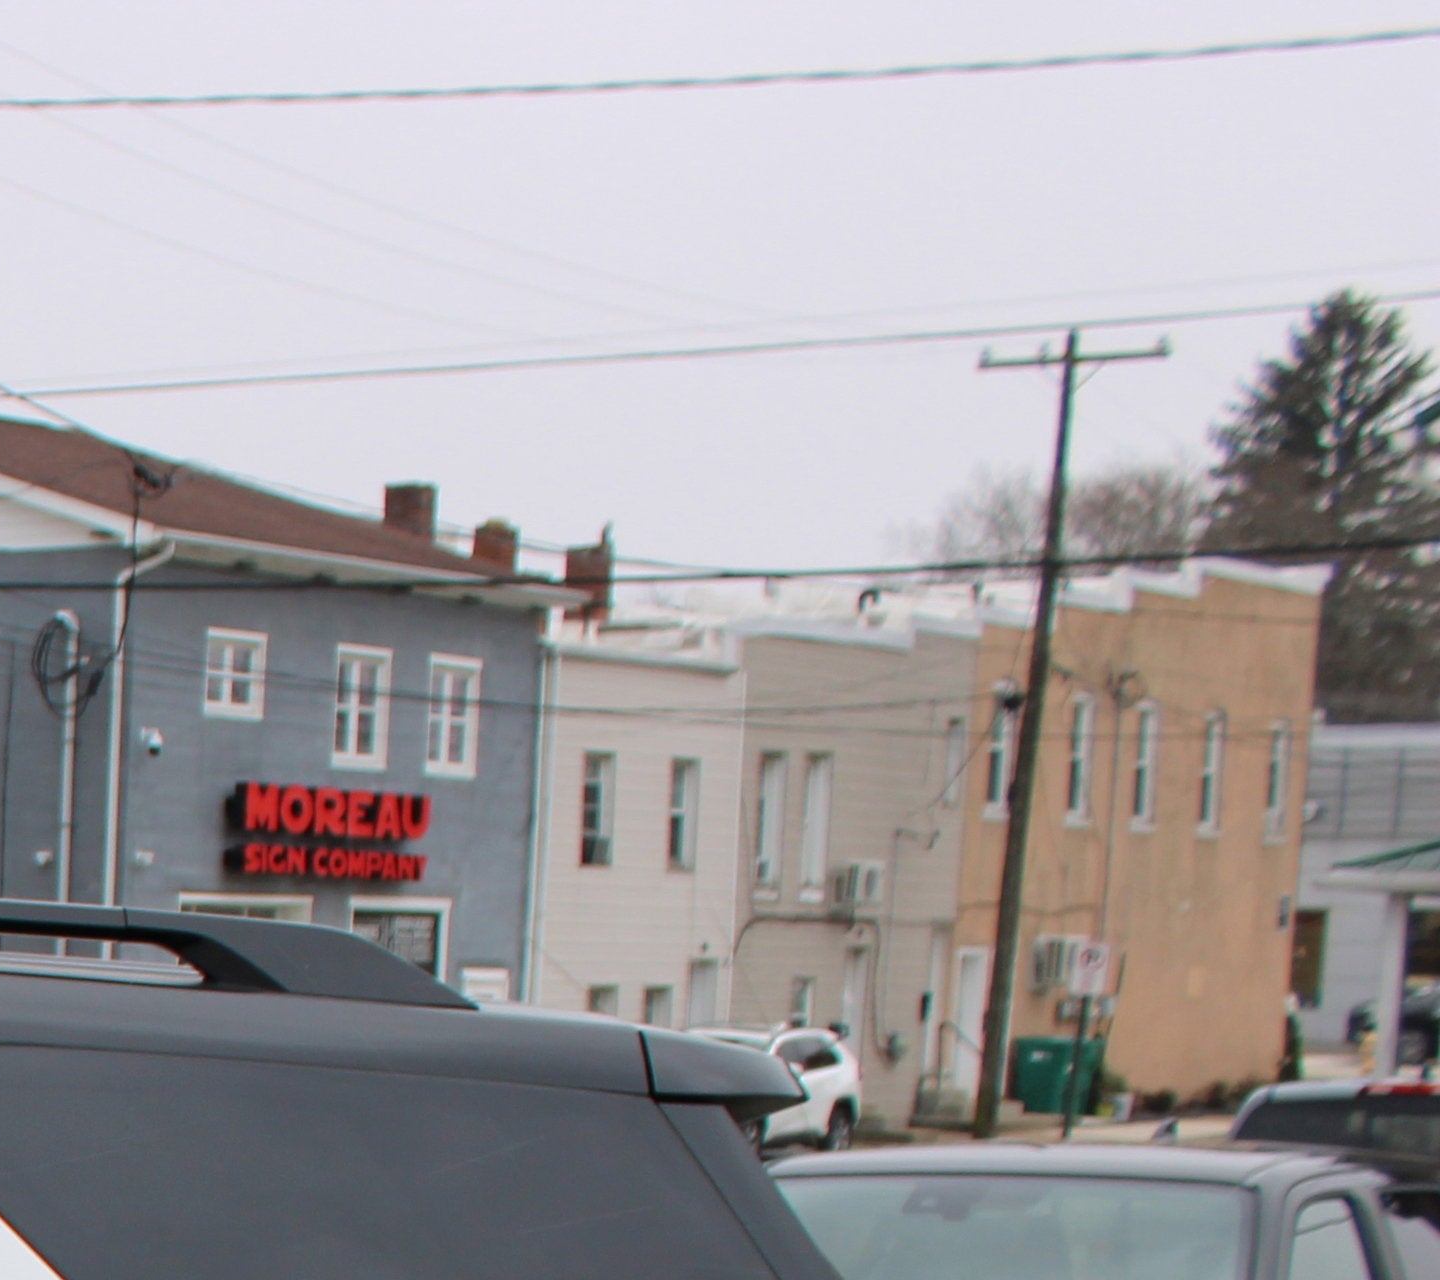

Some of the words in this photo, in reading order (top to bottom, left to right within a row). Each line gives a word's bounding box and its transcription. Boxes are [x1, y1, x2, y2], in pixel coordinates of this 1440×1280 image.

[245, 781, 431, 840] MOREAU
[244, 843, 307, 873] SIGN
[313, 848, 427, 881] COMPANY
